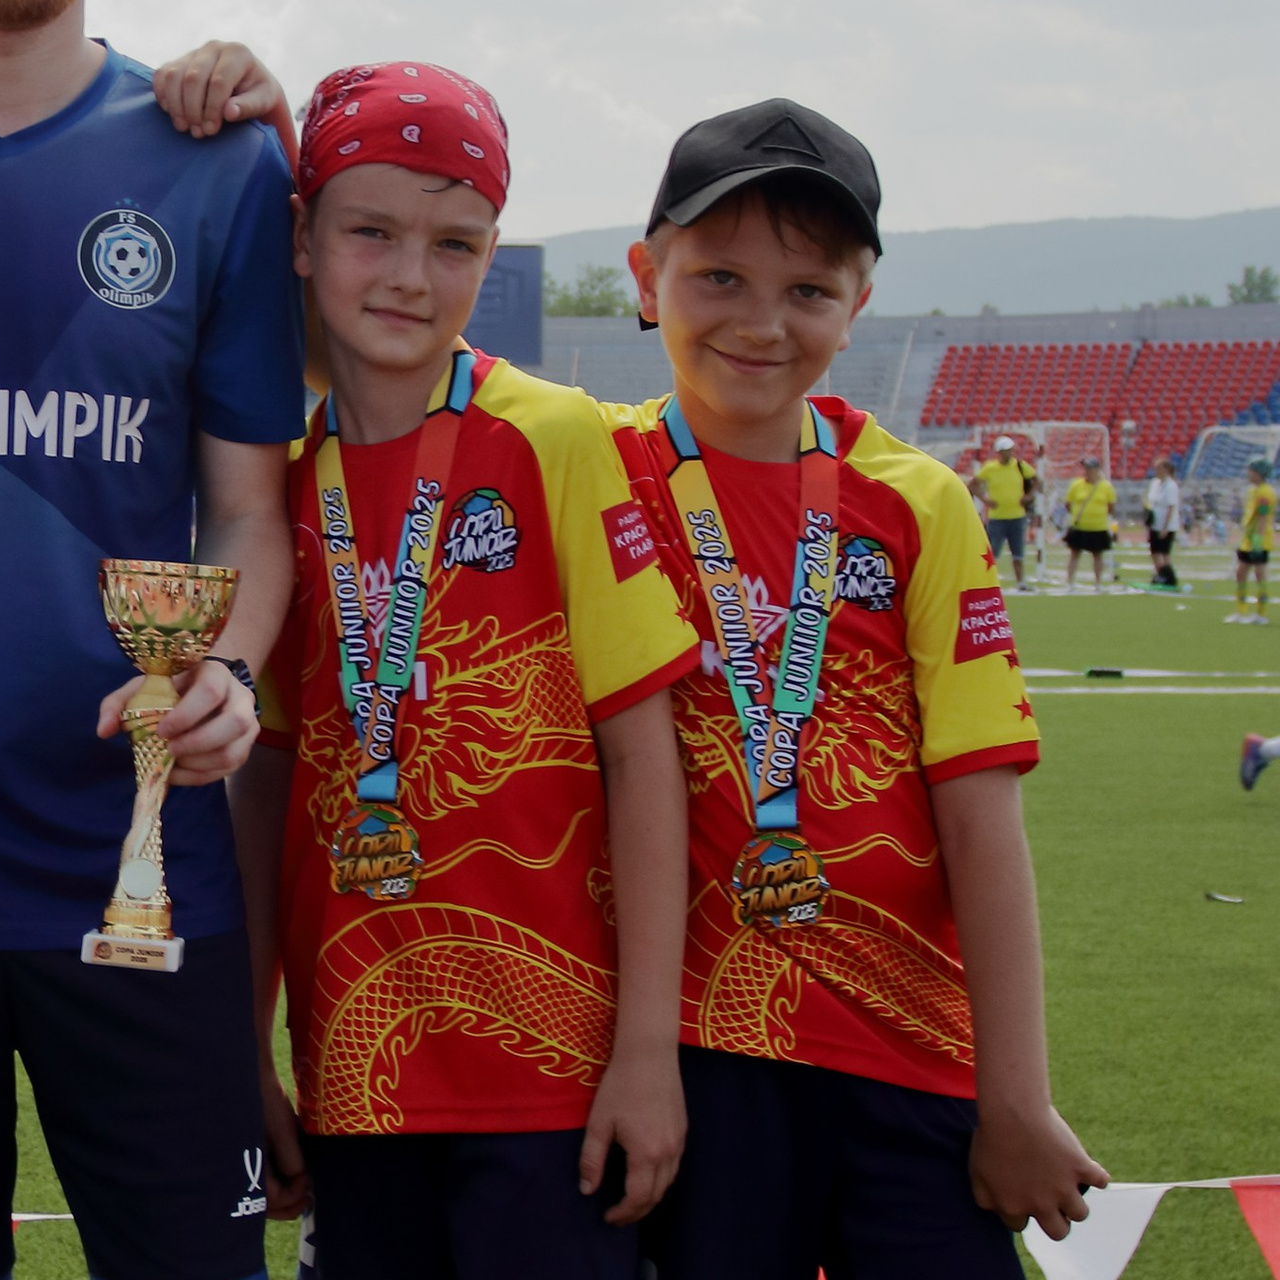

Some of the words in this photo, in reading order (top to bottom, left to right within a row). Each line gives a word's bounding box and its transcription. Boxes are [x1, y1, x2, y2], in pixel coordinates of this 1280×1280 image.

[118, 211, 137, 224] FS
[322, 487, 352, 554] 2025
[449, 507, 503, 539] COPA
[687, 509, 733, 574] 2025
[442, 527, 518, 569] JUNIOR
[368, 685, 402, 760] COPA
[407, 477, 440, 550] 2025
[766, 712, 806, 788] COPA
[802, 508, 833, 578] 2025
[787, 902, 818, 922] 2025
